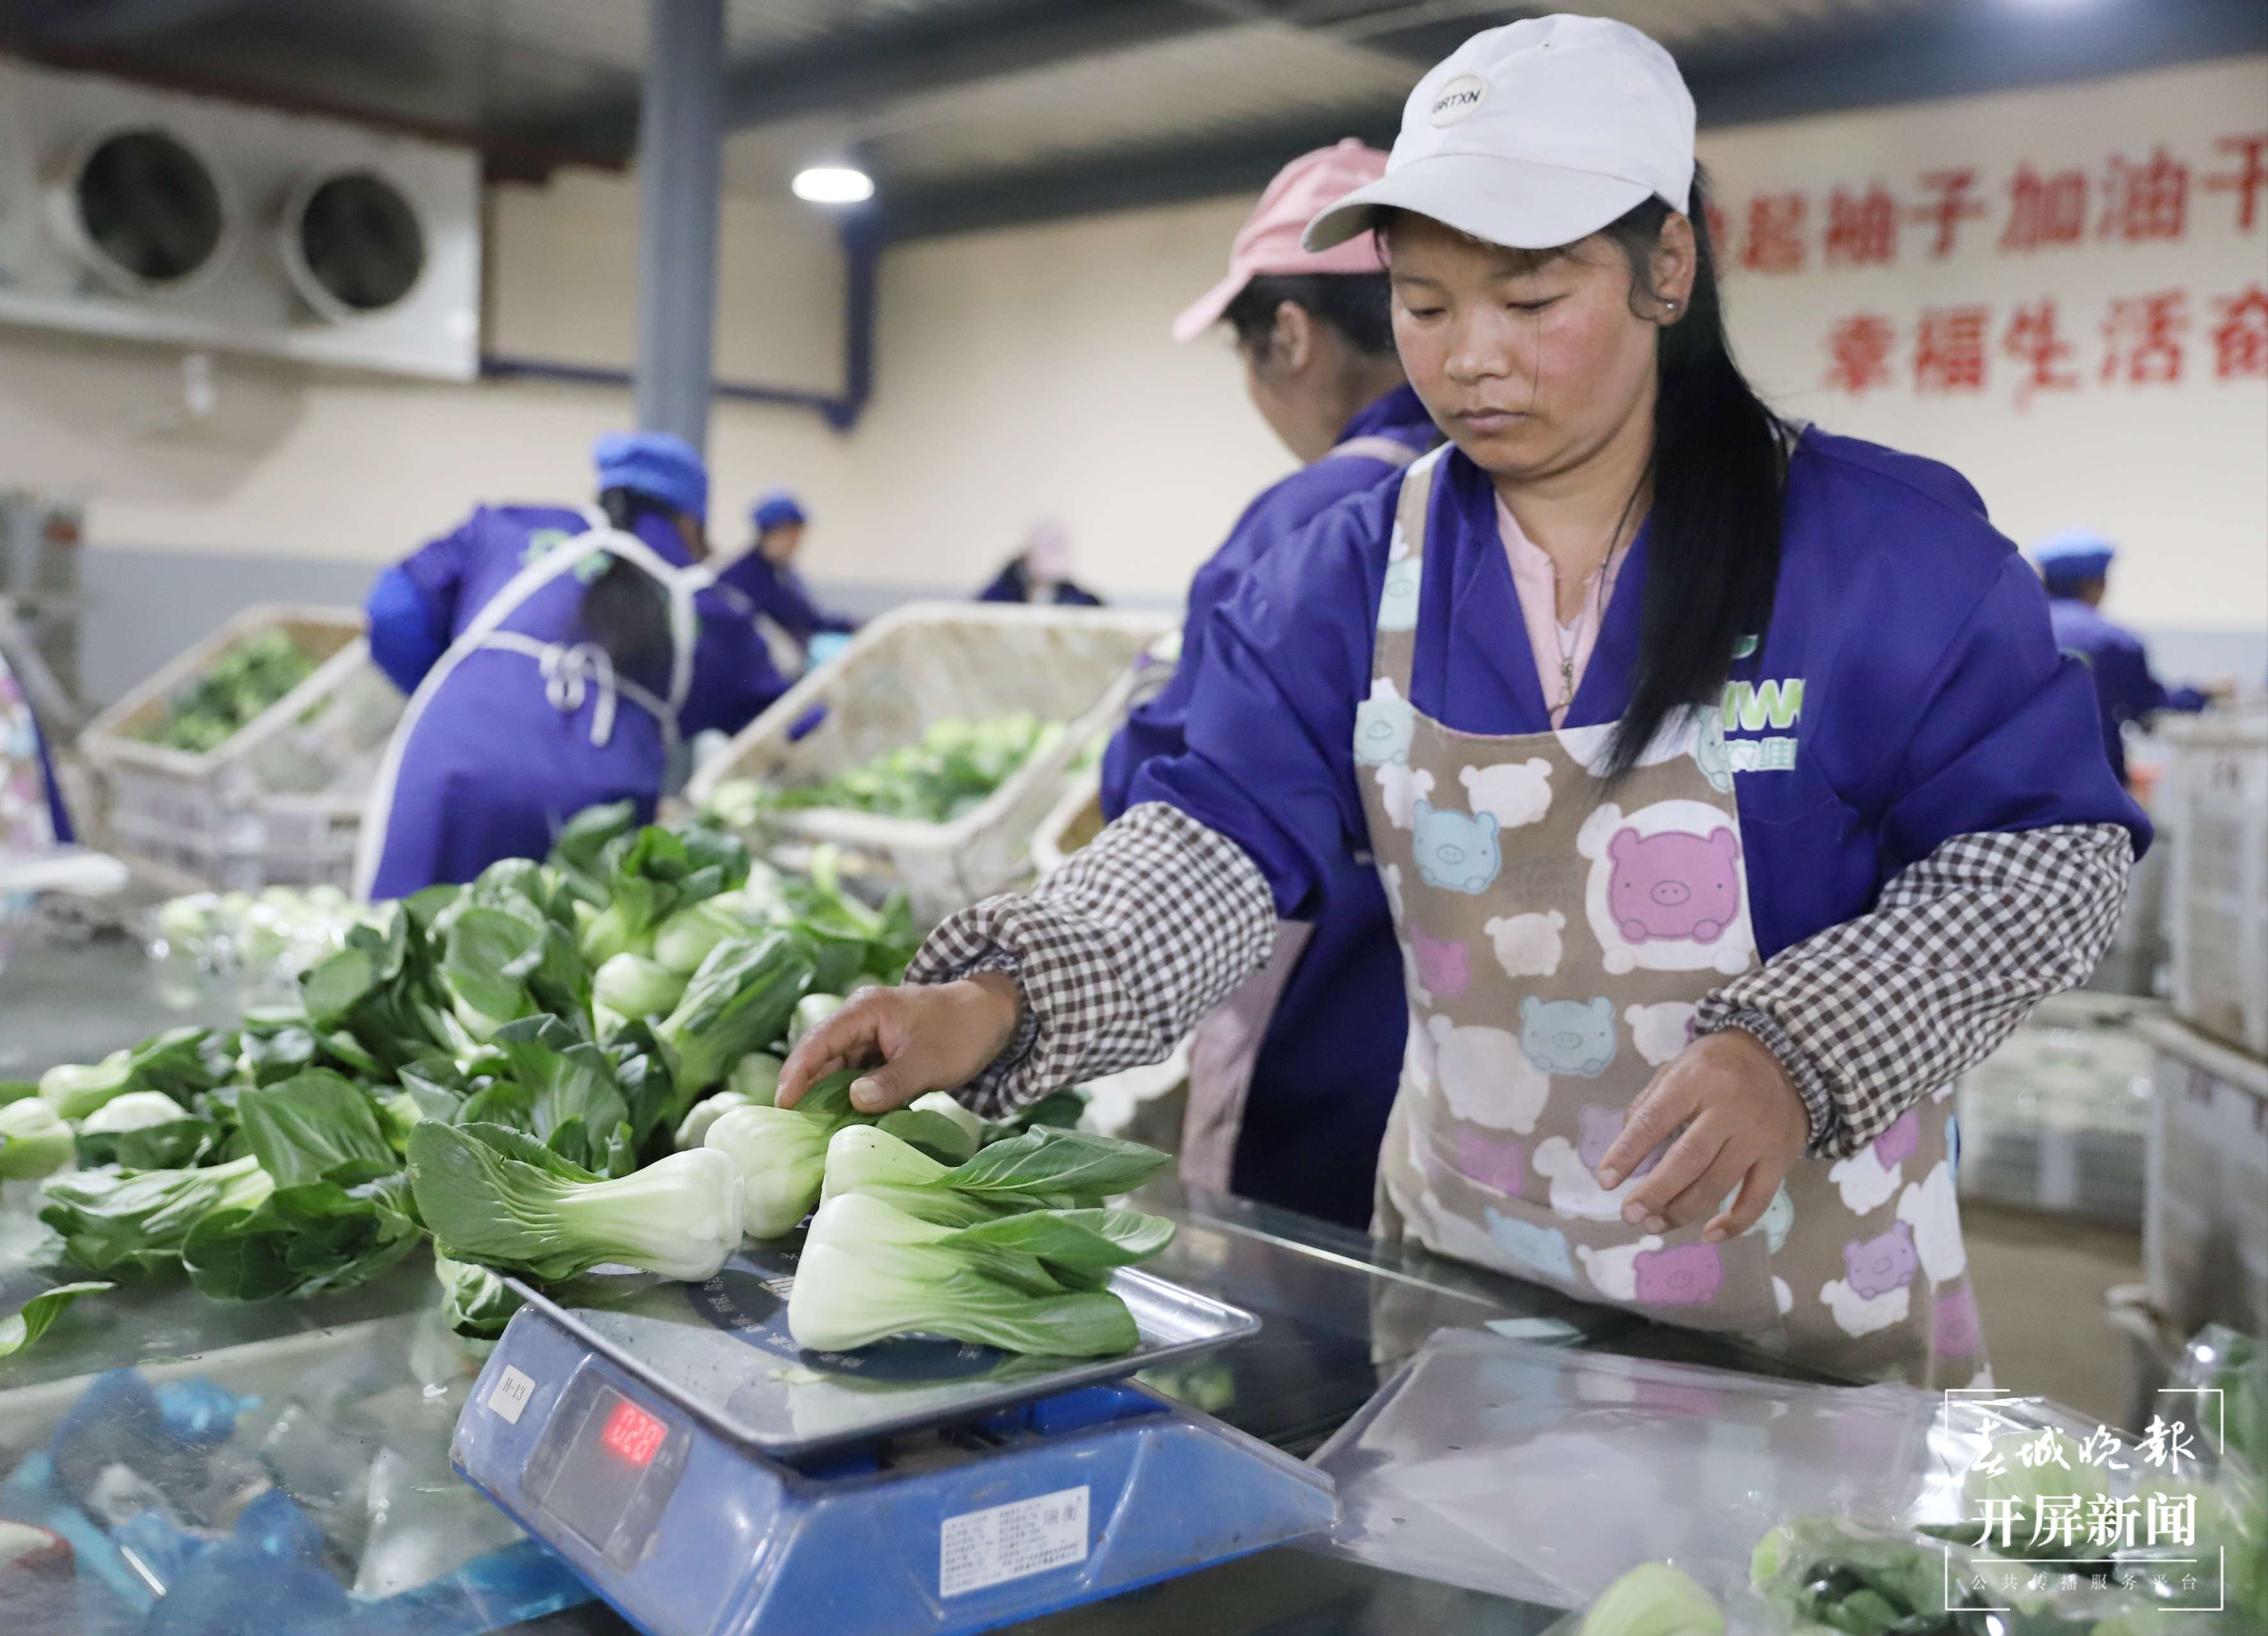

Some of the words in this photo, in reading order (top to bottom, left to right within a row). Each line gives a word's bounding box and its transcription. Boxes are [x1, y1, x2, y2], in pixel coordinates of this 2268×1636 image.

[1705, 134, 2268, 274] 起袖子加油干
[502, 1376, 526, 1401] H-13
